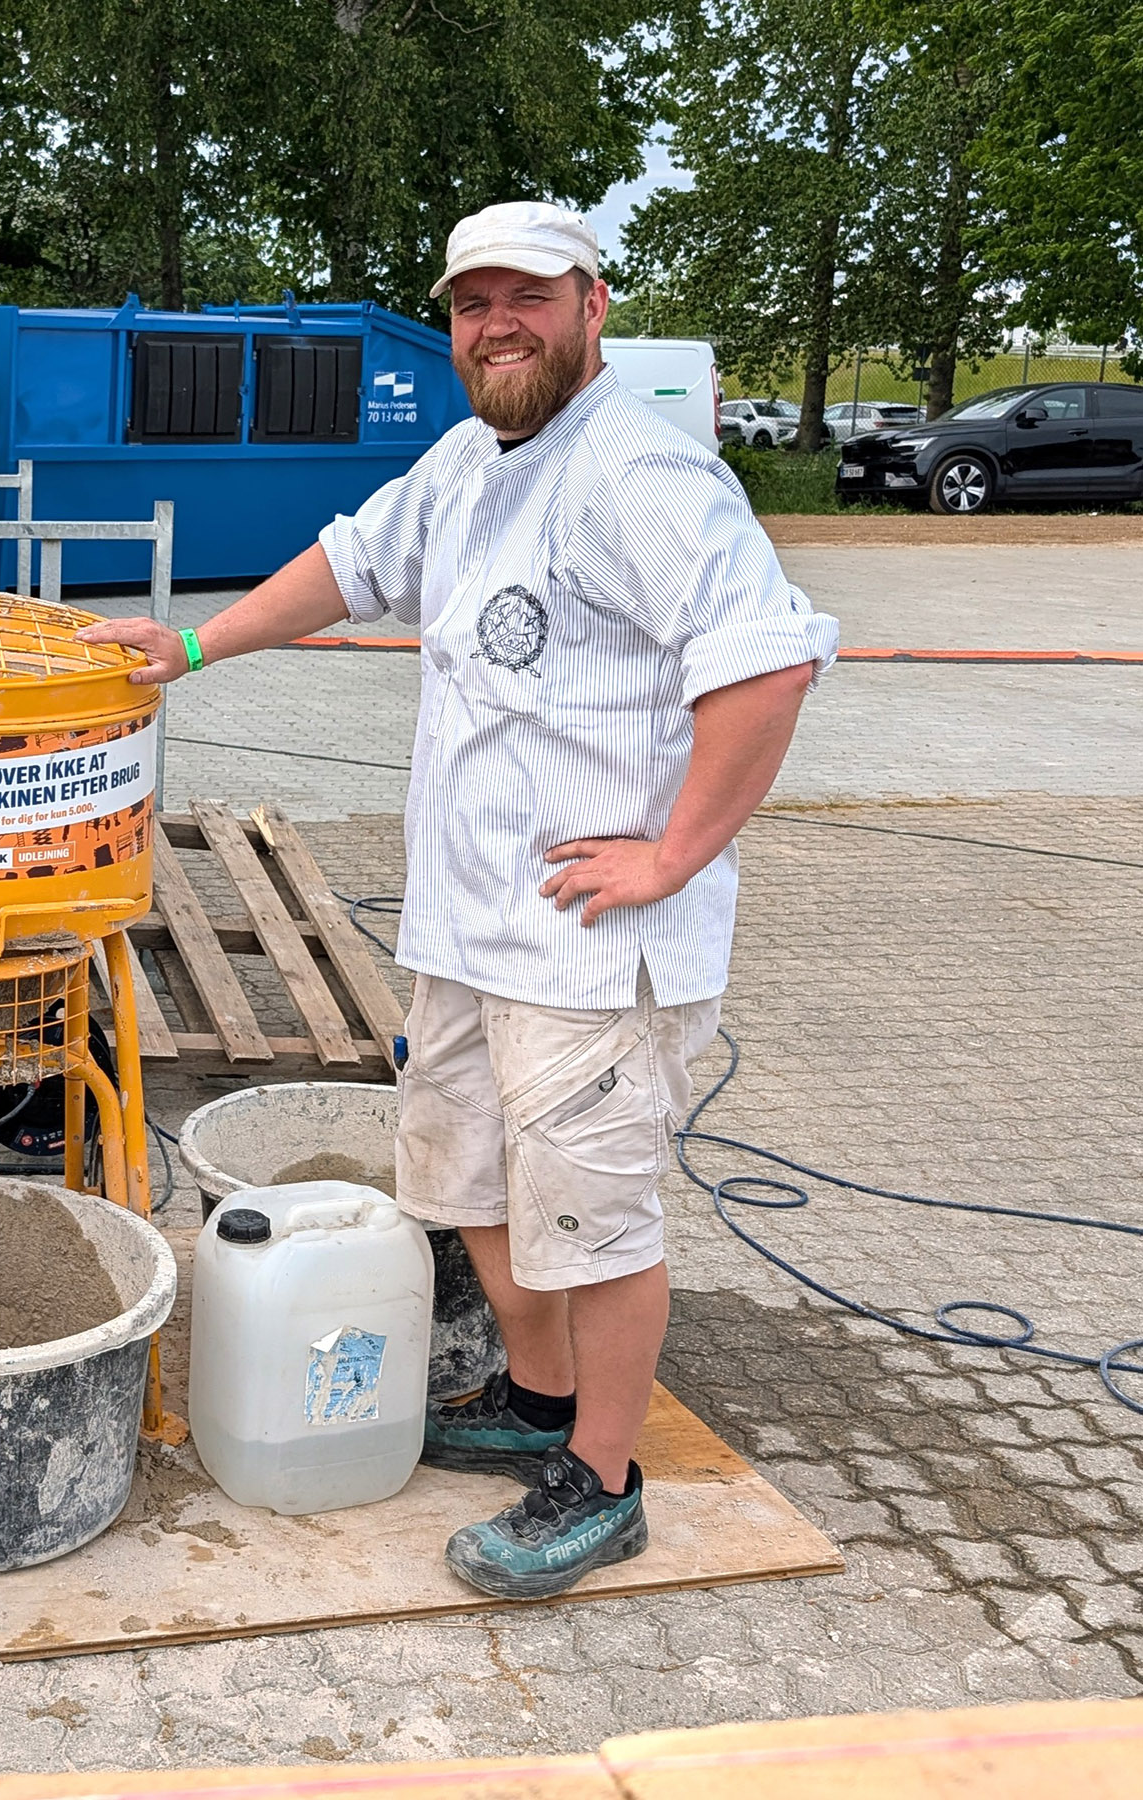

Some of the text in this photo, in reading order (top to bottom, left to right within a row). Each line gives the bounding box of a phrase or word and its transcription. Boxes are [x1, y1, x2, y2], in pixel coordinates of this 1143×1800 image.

[367, 411, 417, 423] 70 13 40 40
[45, 757, 86, 780] IKKE
[89, 752, 107, 773] AT
[61, 774, 108, 801] EFTER
[111, 762, 140, 789] BRUG
[2, 815, 16, 825] for
[18, 813, 33, 825] dig
[35, 811, 49, 822] for
[50, 808, 67, 820] kun
[19, 848, 69, 862] UDLEJNING
